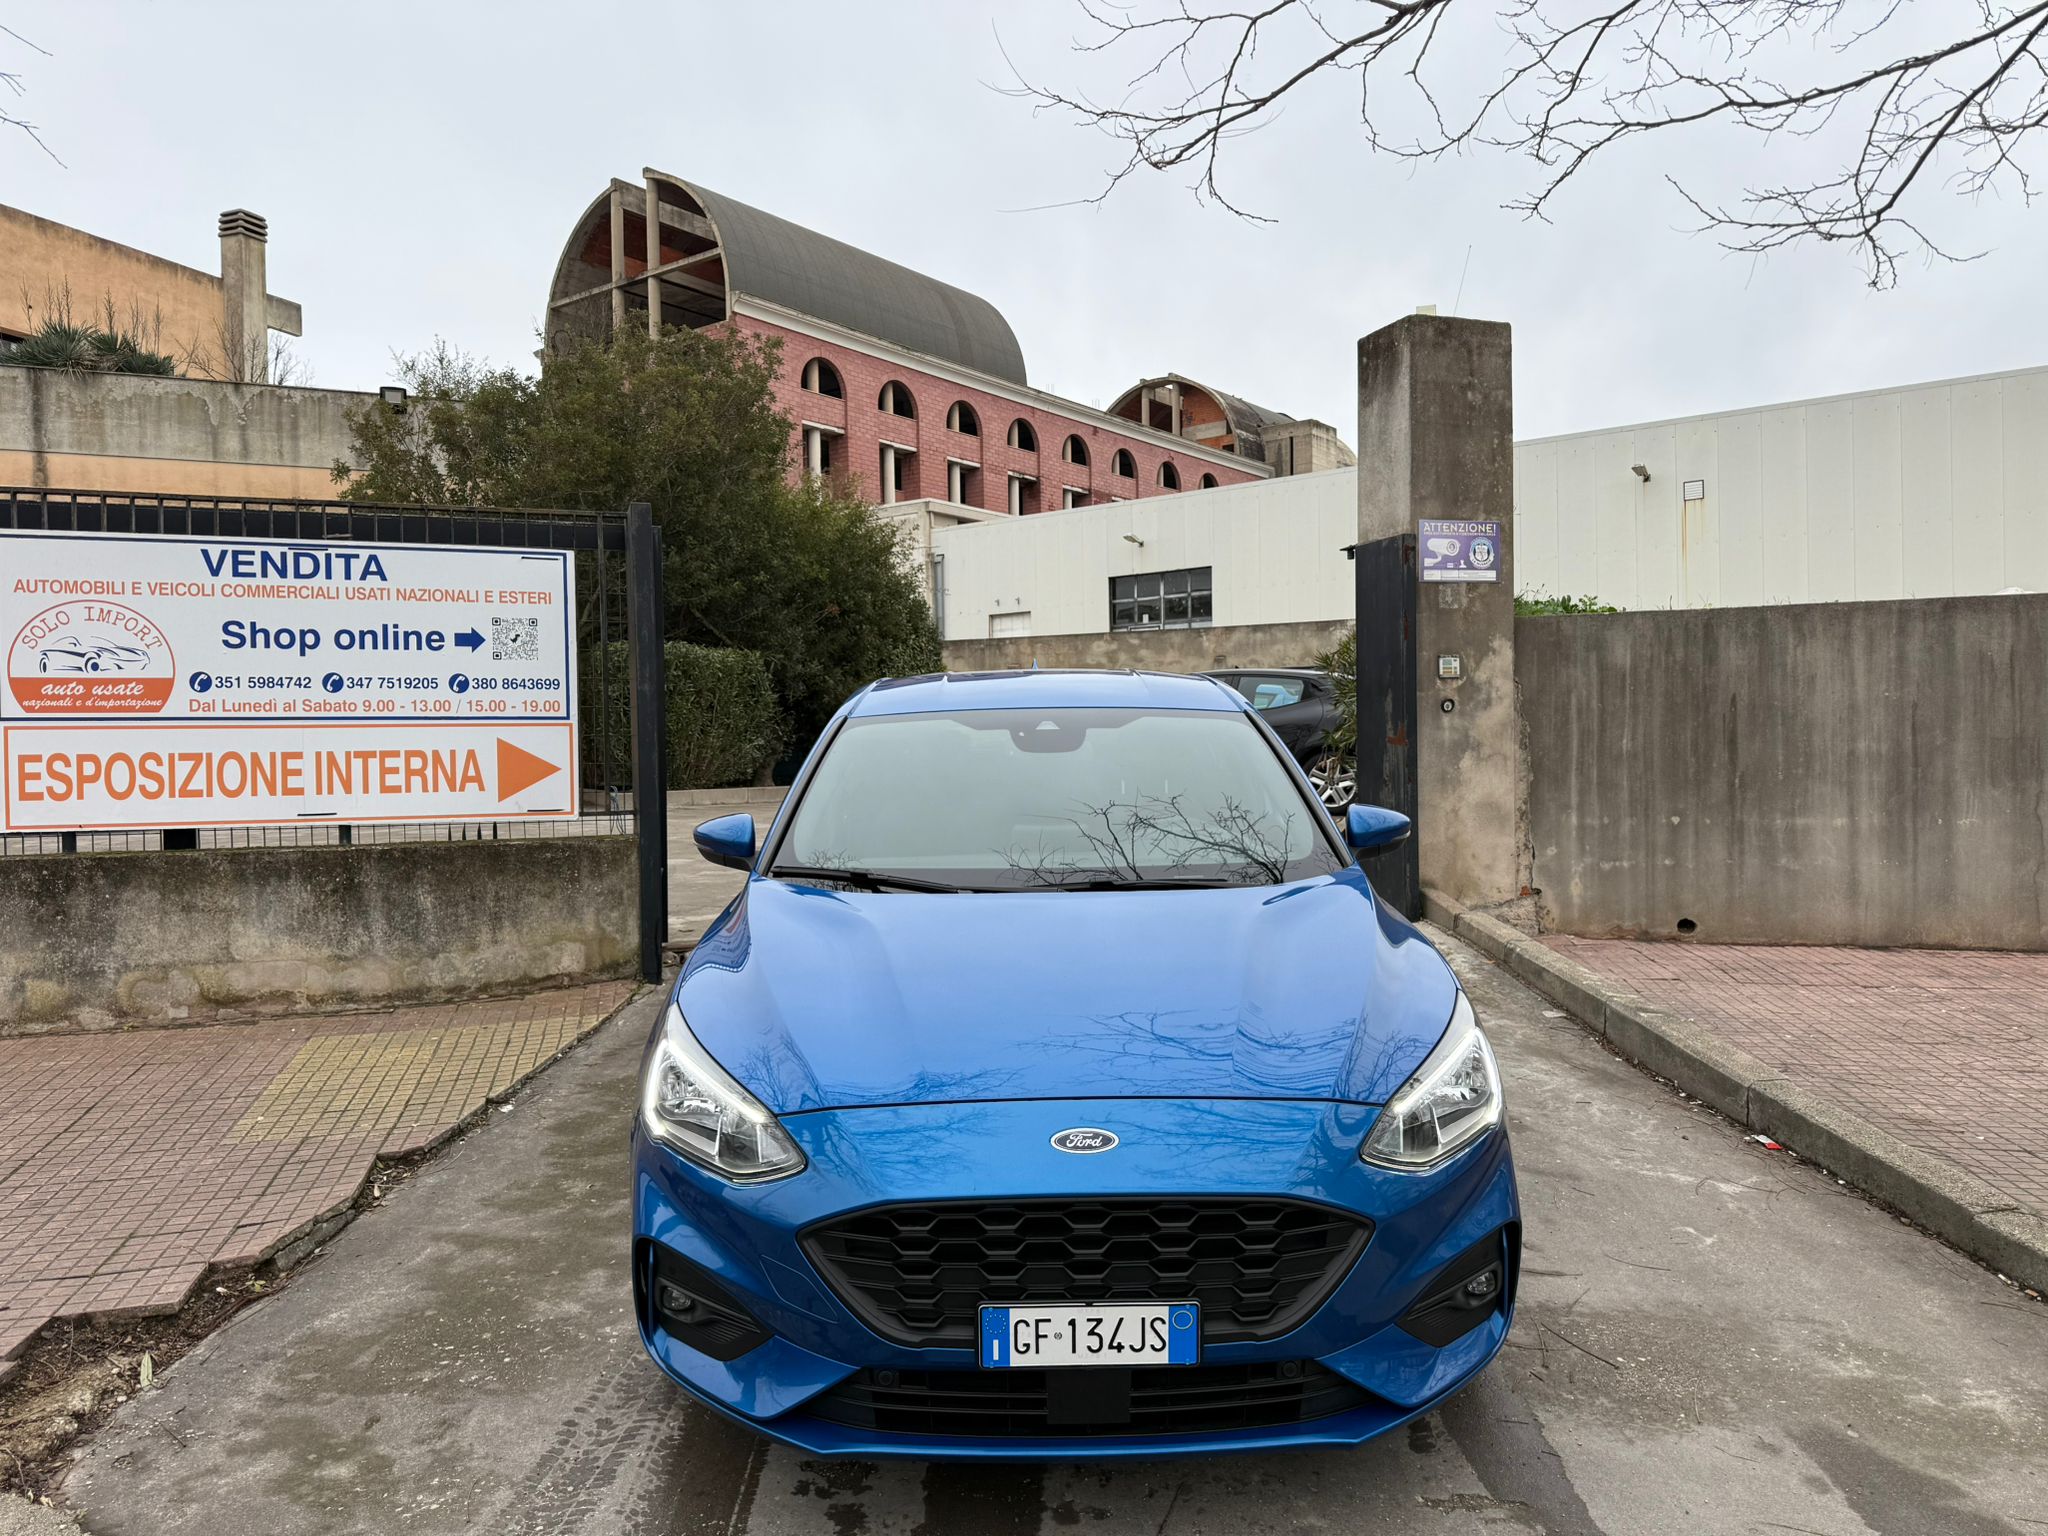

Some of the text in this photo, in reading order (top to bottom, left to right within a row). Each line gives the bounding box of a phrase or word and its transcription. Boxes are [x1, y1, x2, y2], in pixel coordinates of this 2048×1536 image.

[1424, 522, 1496, 534] ATTENZIONE!
[201, 549, 388, 582] VENDITA
[13, 579, 552, 605] AUTOMOBILI E VEICOLI COMMERCIALI USATI NAZIONALI E ESTERI
[22, 606, 163, 650] SOLO IMPORT
[221, 620, 446, 657] Shop online
[41, 681, 144, 696] auto usate
[215, 676, 312, 689] 351 5984742
[346, 677, 439, 690] 347 7519205
[472, 678, 561, 690] 380 8643699
[22, 697, 73, 709] nazionali
[85, 696, 163, 710] d'importazione
[189, 699, 215, 712] Dal
[222, 697, 277, 713] Lunedì
[283, 699, 296, 712] al
[302, 698, 357, 713] Sabato
[362, 700, 395, 713] 9.00
[411, 700, 451, 713] 13.00
[467, 700, 507, 713] 15.00
[522, 700, 561, 713] 19.00
[17, 749, 486, 802] ESPOSIZIONE INTERNA
[1066, 1133, 1103, 1147] Ford
